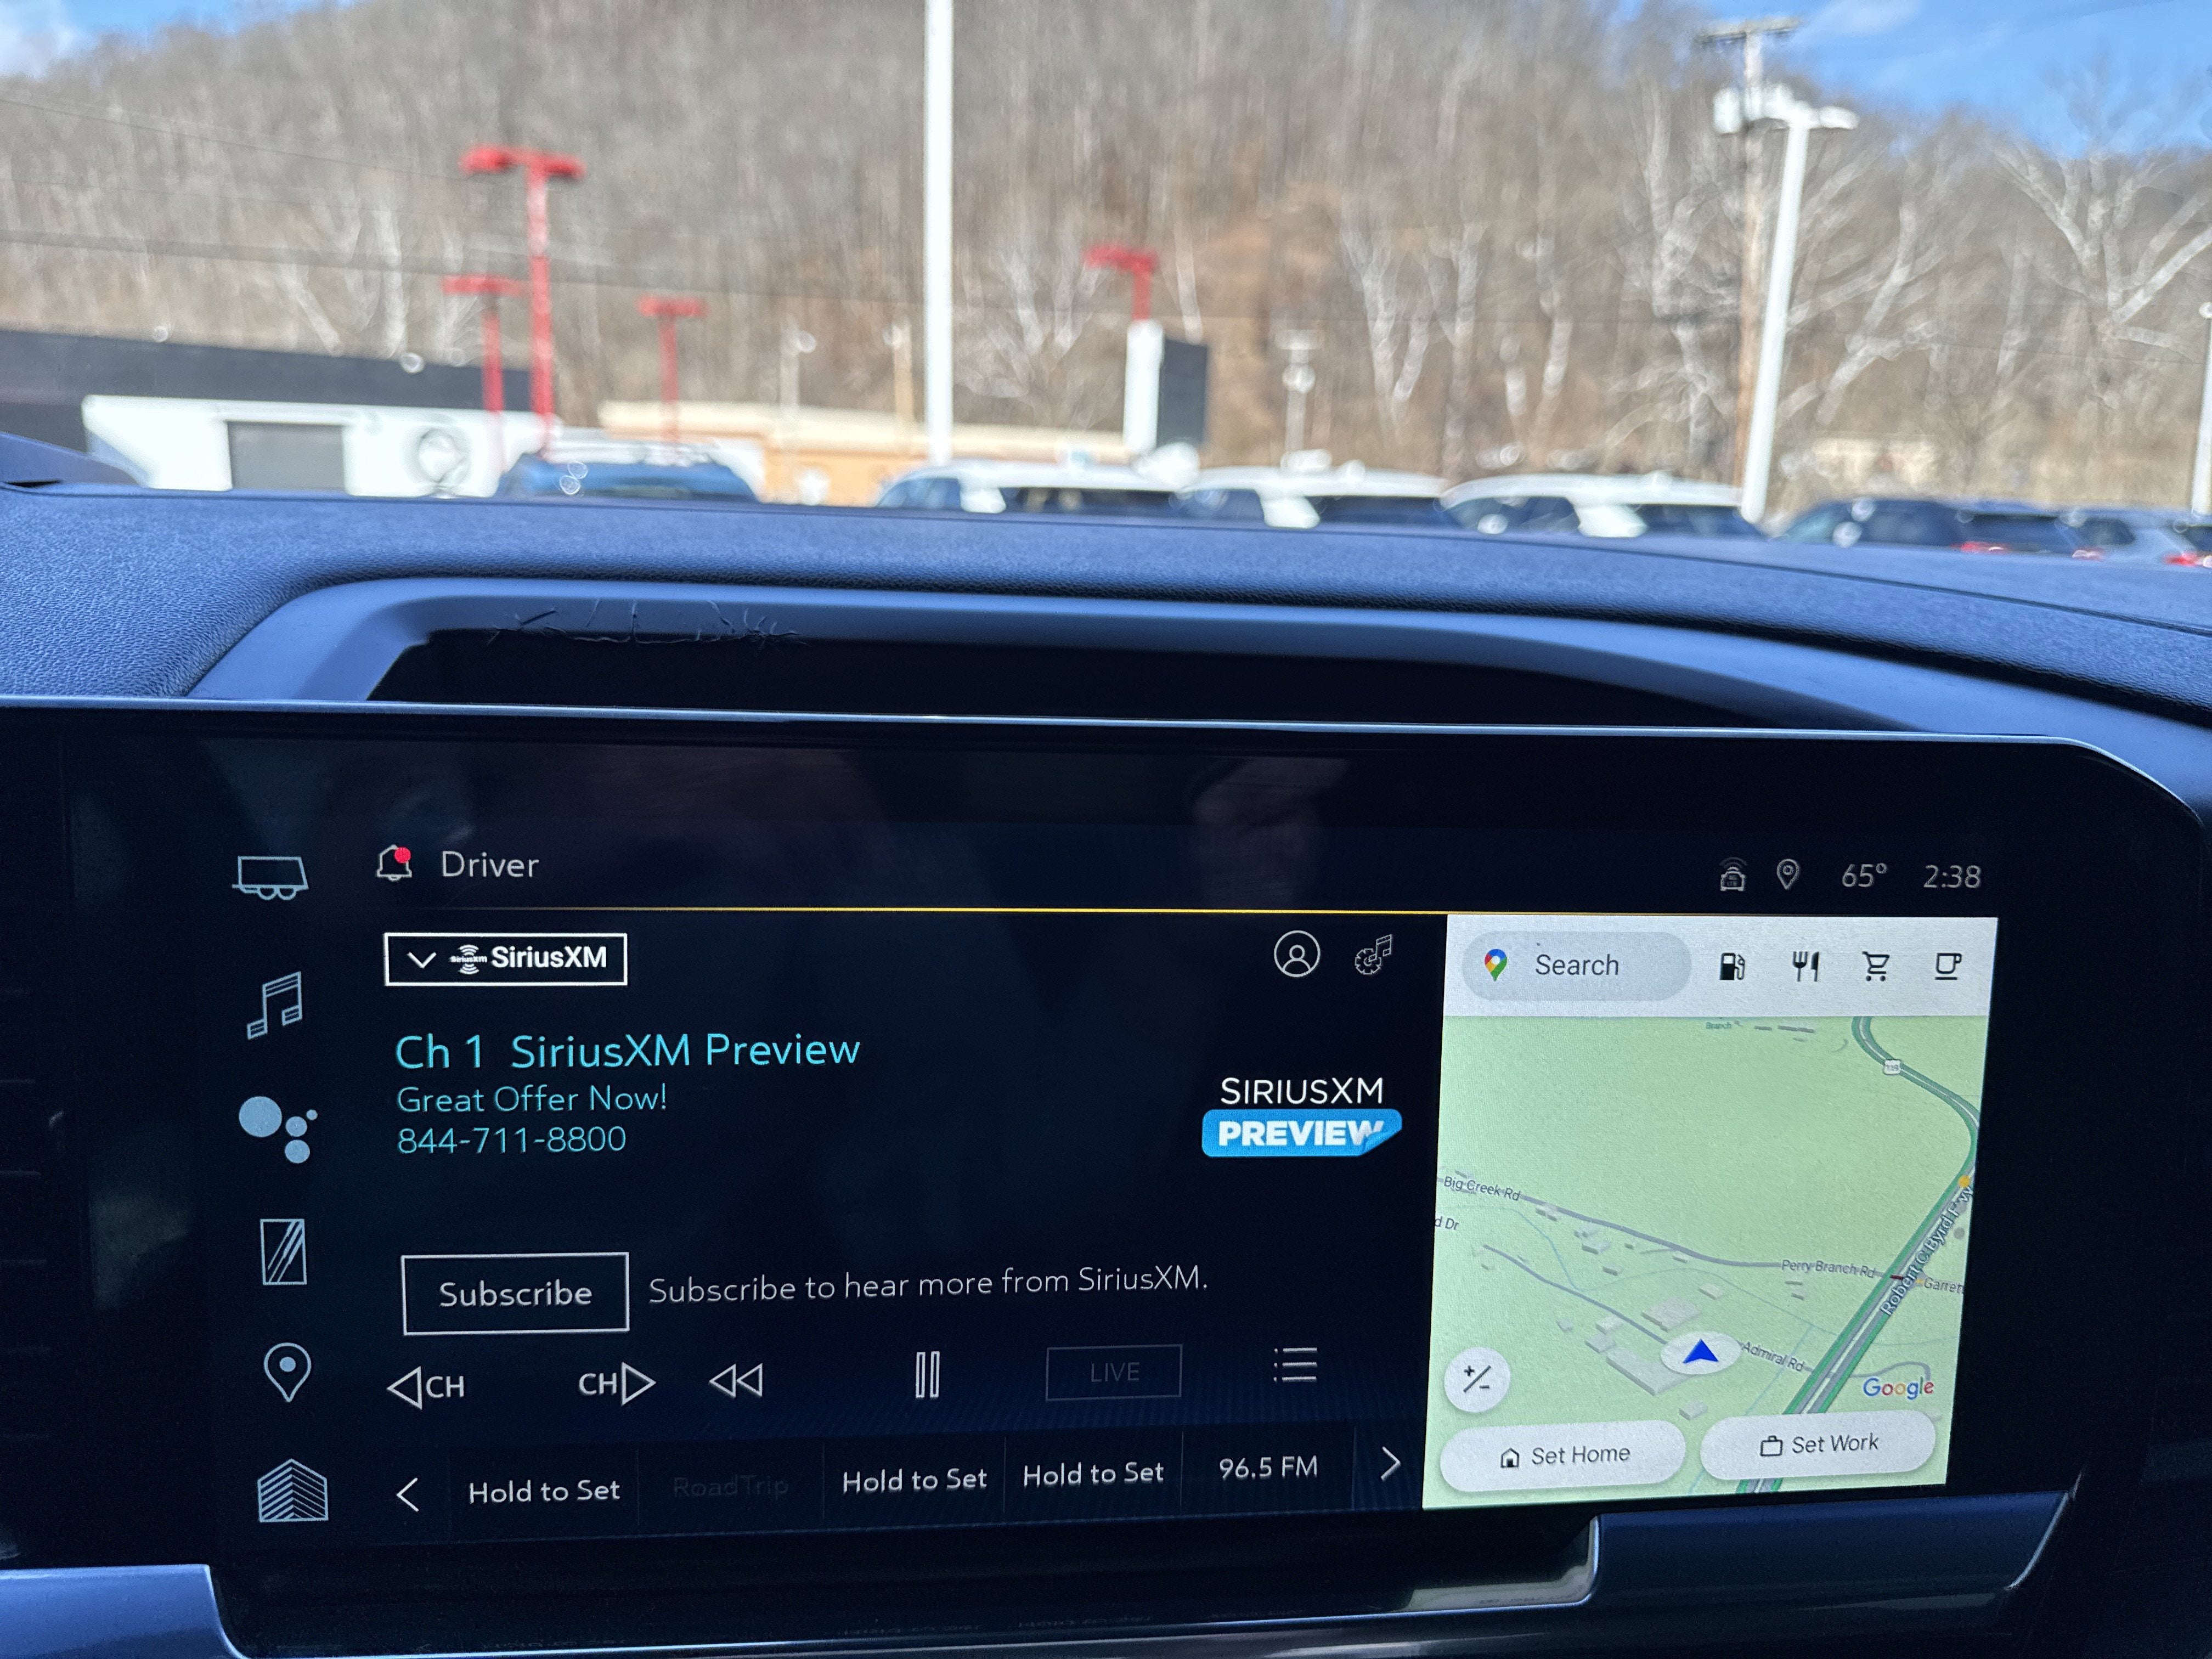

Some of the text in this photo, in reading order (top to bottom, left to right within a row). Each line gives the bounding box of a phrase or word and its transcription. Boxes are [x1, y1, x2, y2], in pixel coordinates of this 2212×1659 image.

[442, 850, 539, 878] Driver
[1923, 864, 1981, 888] 2:38
[491, 945, 607, 968] SiriusXM
[1535, 953, 1619, 976] Search
[396, 1032, 860, 1069] Ch 1 SiriusXM Preview
[397, 1082, 666, 1113] Great Offer Now!
[1221, 1077, 1383, 1105] SIRIUSXM
[398, 1126, 626, 1154] 844-711-8800
[1218, 1119, 1385, 1147] PREVIEW
[1444, 1176, 1521, 1201] Big Creek Rd
[1445, 1217, 1460, 1231] Dr
[1781, 1259, 1876, 1278] Perry Branch Rd
[1880, 1262, 1920, 1317] Robert
[1915, 1251, 1928, 1264] C
[1923, 1214, 1955, 1252] Byrd
[439, 1278, 592, 1307] Subscribe
[650, 1265, 1207, 1303] Subscribe to hear more from SiriusXM.
[1741, 1341, 1805, 1372] Admiral Rd
[578, 1372, 617, 1395] CH
[1091, 1362, 1140, 1383] LIVE
[426, 1375, 465, 1398] CH
[1863, 1377, 1934, 1400] Google
[1531, 1446, 1630, 1465] Set Home
[1792, 1432, 1879, 1454] Set Work
[1024, 1462, 1164, 1487] Hold to Set
[1219, 1455, 1317, 1480] 96.5 FM
[469, 1479, 620, 1504] Hold to Set
[674, 1473, 788, 1500] RoadTrip
[843, 1468, 988, 1493] Hold to Set
